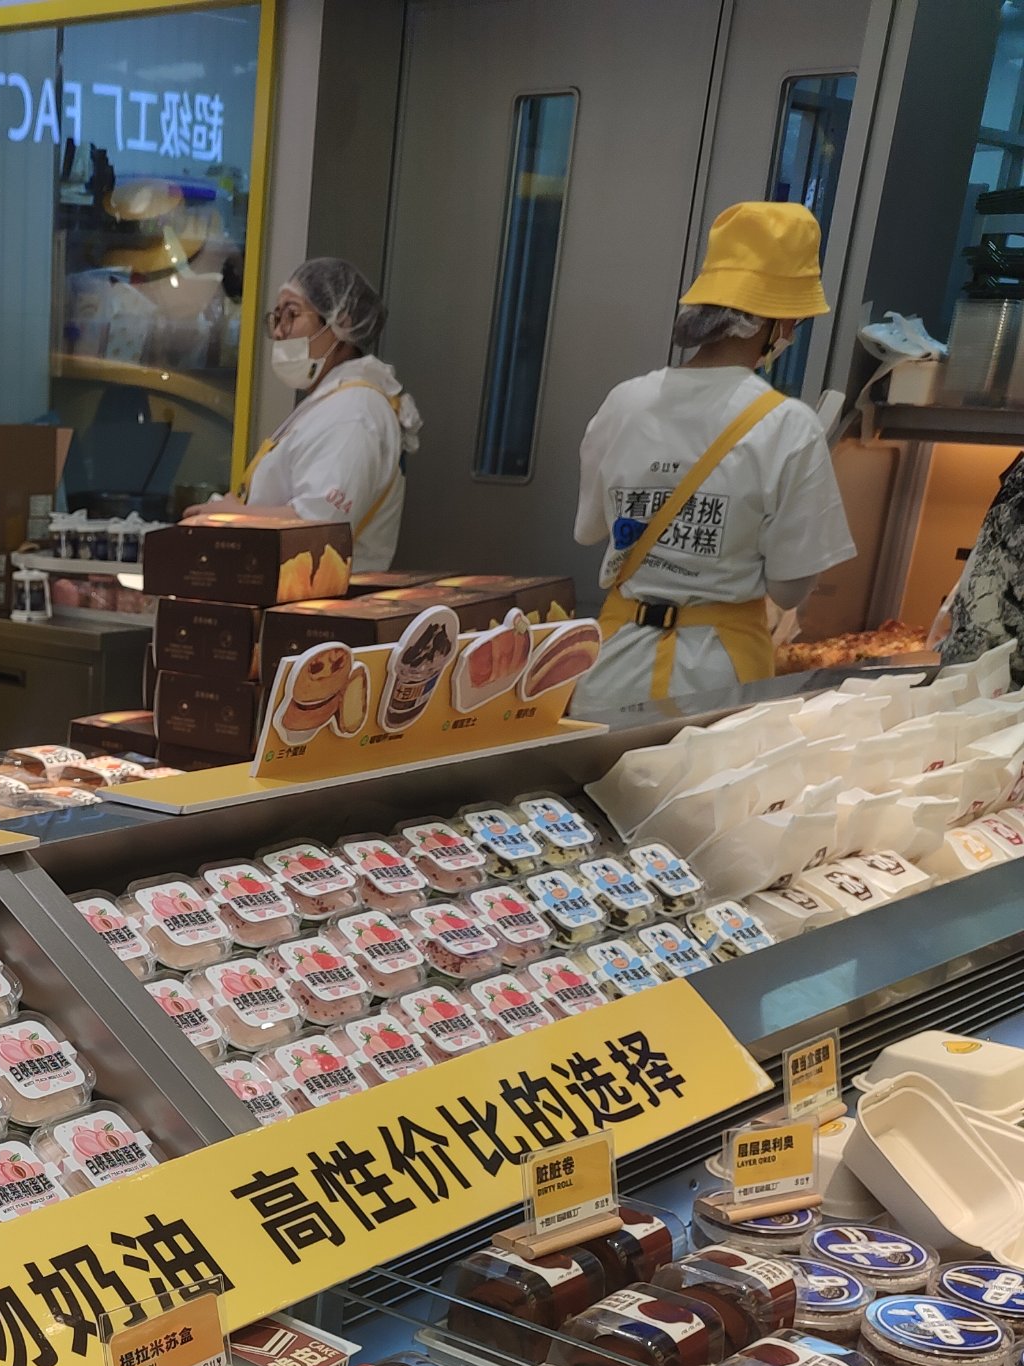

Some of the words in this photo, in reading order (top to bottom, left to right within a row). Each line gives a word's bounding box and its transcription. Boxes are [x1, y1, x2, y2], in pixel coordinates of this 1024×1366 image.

[231, 1030, 687, 1265] 高性价比的选择
[738, 1135, 794, 1158] 层层奥利奥
[536, 1155, 575, 1185] 脏脏卷
[737, 1157, 757, 1168] LAYER
[758, 1155, 777, 1166] OREO
[537, 1182, 555, 1197] DIRTY
[556, 1178, 574, 1192] ROLL
[308, 1341, 337, 1359] CAKE
